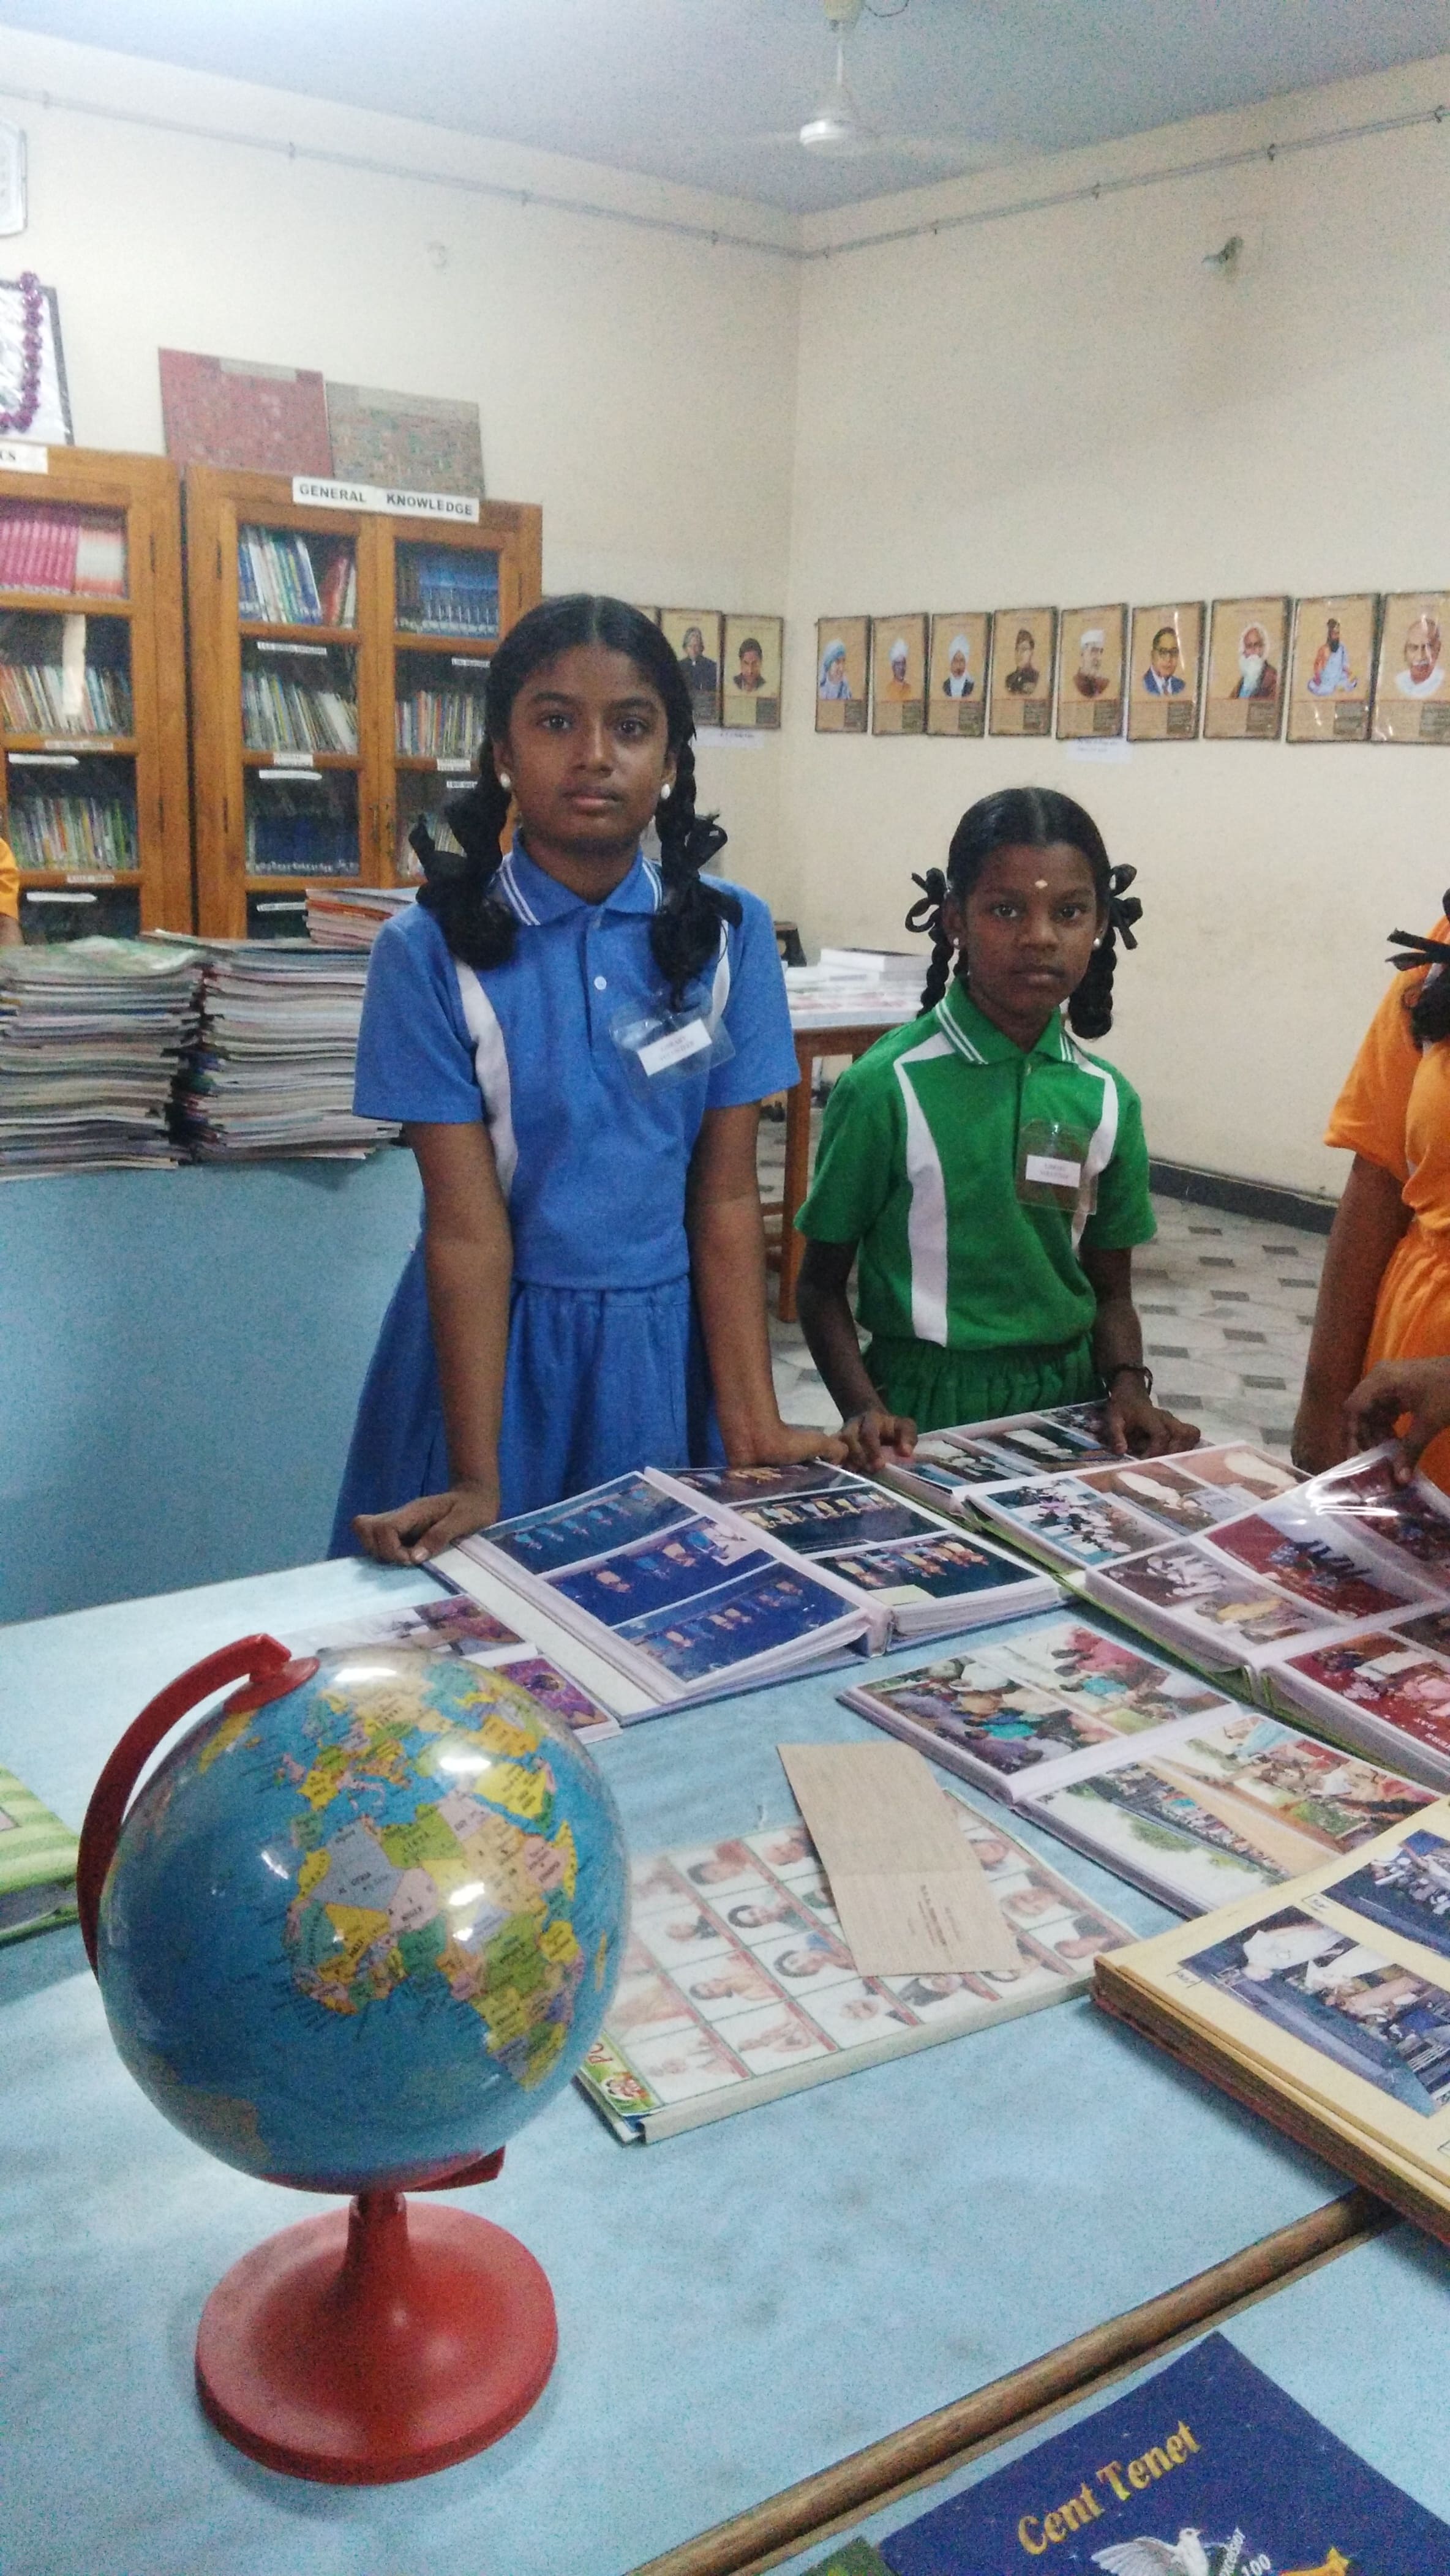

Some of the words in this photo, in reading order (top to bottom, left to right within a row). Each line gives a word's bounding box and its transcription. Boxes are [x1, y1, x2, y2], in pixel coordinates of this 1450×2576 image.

[299, 483, 366, 503] GENERAL
[386, 493, 473, 515] KNOWLEDGE
[1018, 2481, 1105, 2555] Cent
[1096, 2419, 1202, 2501] Tenet
